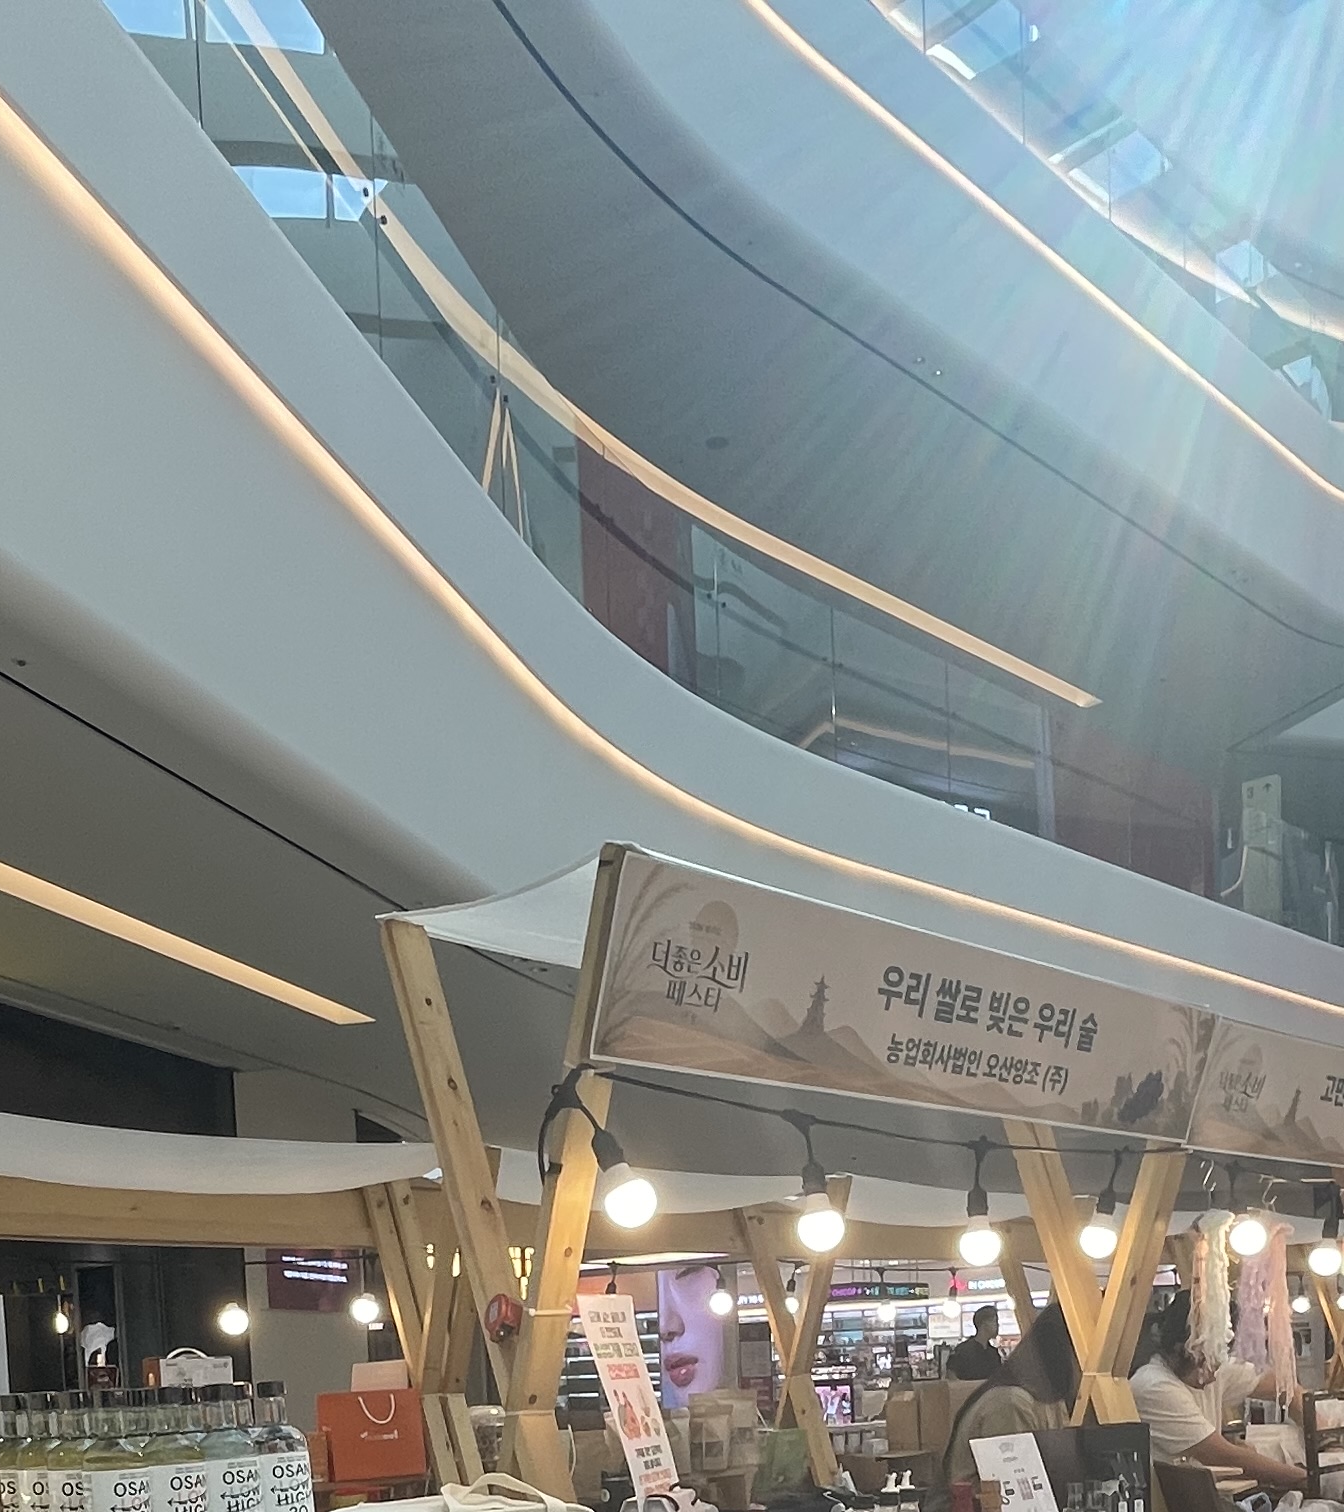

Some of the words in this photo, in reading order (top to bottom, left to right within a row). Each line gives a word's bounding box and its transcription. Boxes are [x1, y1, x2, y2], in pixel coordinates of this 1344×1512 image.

[666, 980, 721, 1013] 페스타
[877, 966, 932, 1019] 우리
[934, 977, 983, 1025] 쌀로
[986, 990, 1030, 1038] 빚은
[1032, 1003, 1077, 1049] 우리
[1076, 1012, 1098, 1053] 술
[886, 1033, 983, 1078] 농업회사법인
[983, 1053, 1042, 1086] 오산양조
[1042, 1065, 1069, 1096] (주)
